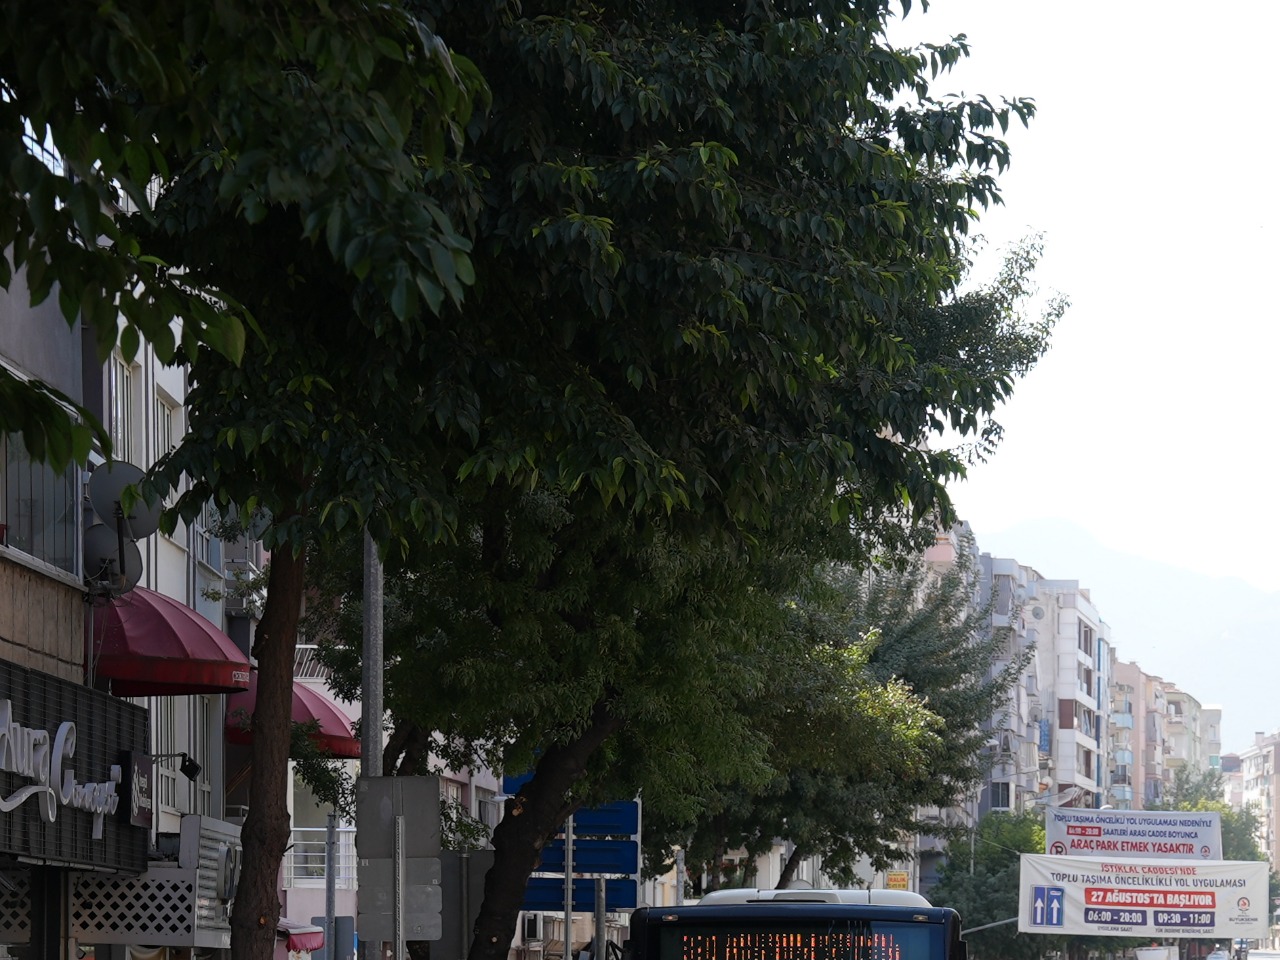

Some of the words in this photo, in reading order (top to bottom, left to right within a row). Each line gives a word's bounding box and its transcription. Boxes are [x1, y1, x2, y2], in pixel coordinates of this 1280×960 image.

[1054, 814, 1072, 822] TOPLU
[1126, 817, 1138, 825] YOL
[1139, 818, 1178, 826] UYGULAMASI
[1102, 828, 1128, 837] SAATLERİ
[1129, 829, 1147, 837] ARASI
[1148, 830, 1168, 838] CADDE
[1168, 830, 1198, 839] BOYUNCA
[1070, 839, 1094, 853] ARAÇ
[1096, 841, 1119, 851] PARK
[1121, 842, 1149, 852] ETMEK
[1151, 842, 1194, 854] YASAKTIR
[1051, 872, 1078, 882] TOPLU
[1081, 874, 1112, 885] TAŞIMA
[1174, 878, 1190, 887] YOL
[1192, 879, 1246, 888] UYGULAMASI
[1091, 891, 1104, 902] 27
[1105, 889, 1164, 904] AĞUSTOS'TA
[1167, 894, 1212, 907] BAŞLIYOR
[1088, 910, 1111, 921] 06:00
[1120, 912, 1142, 923] 20:00
[1158, 913, 1180, 923] 09:30
[1189, 914, 1211, 924] 11:00
